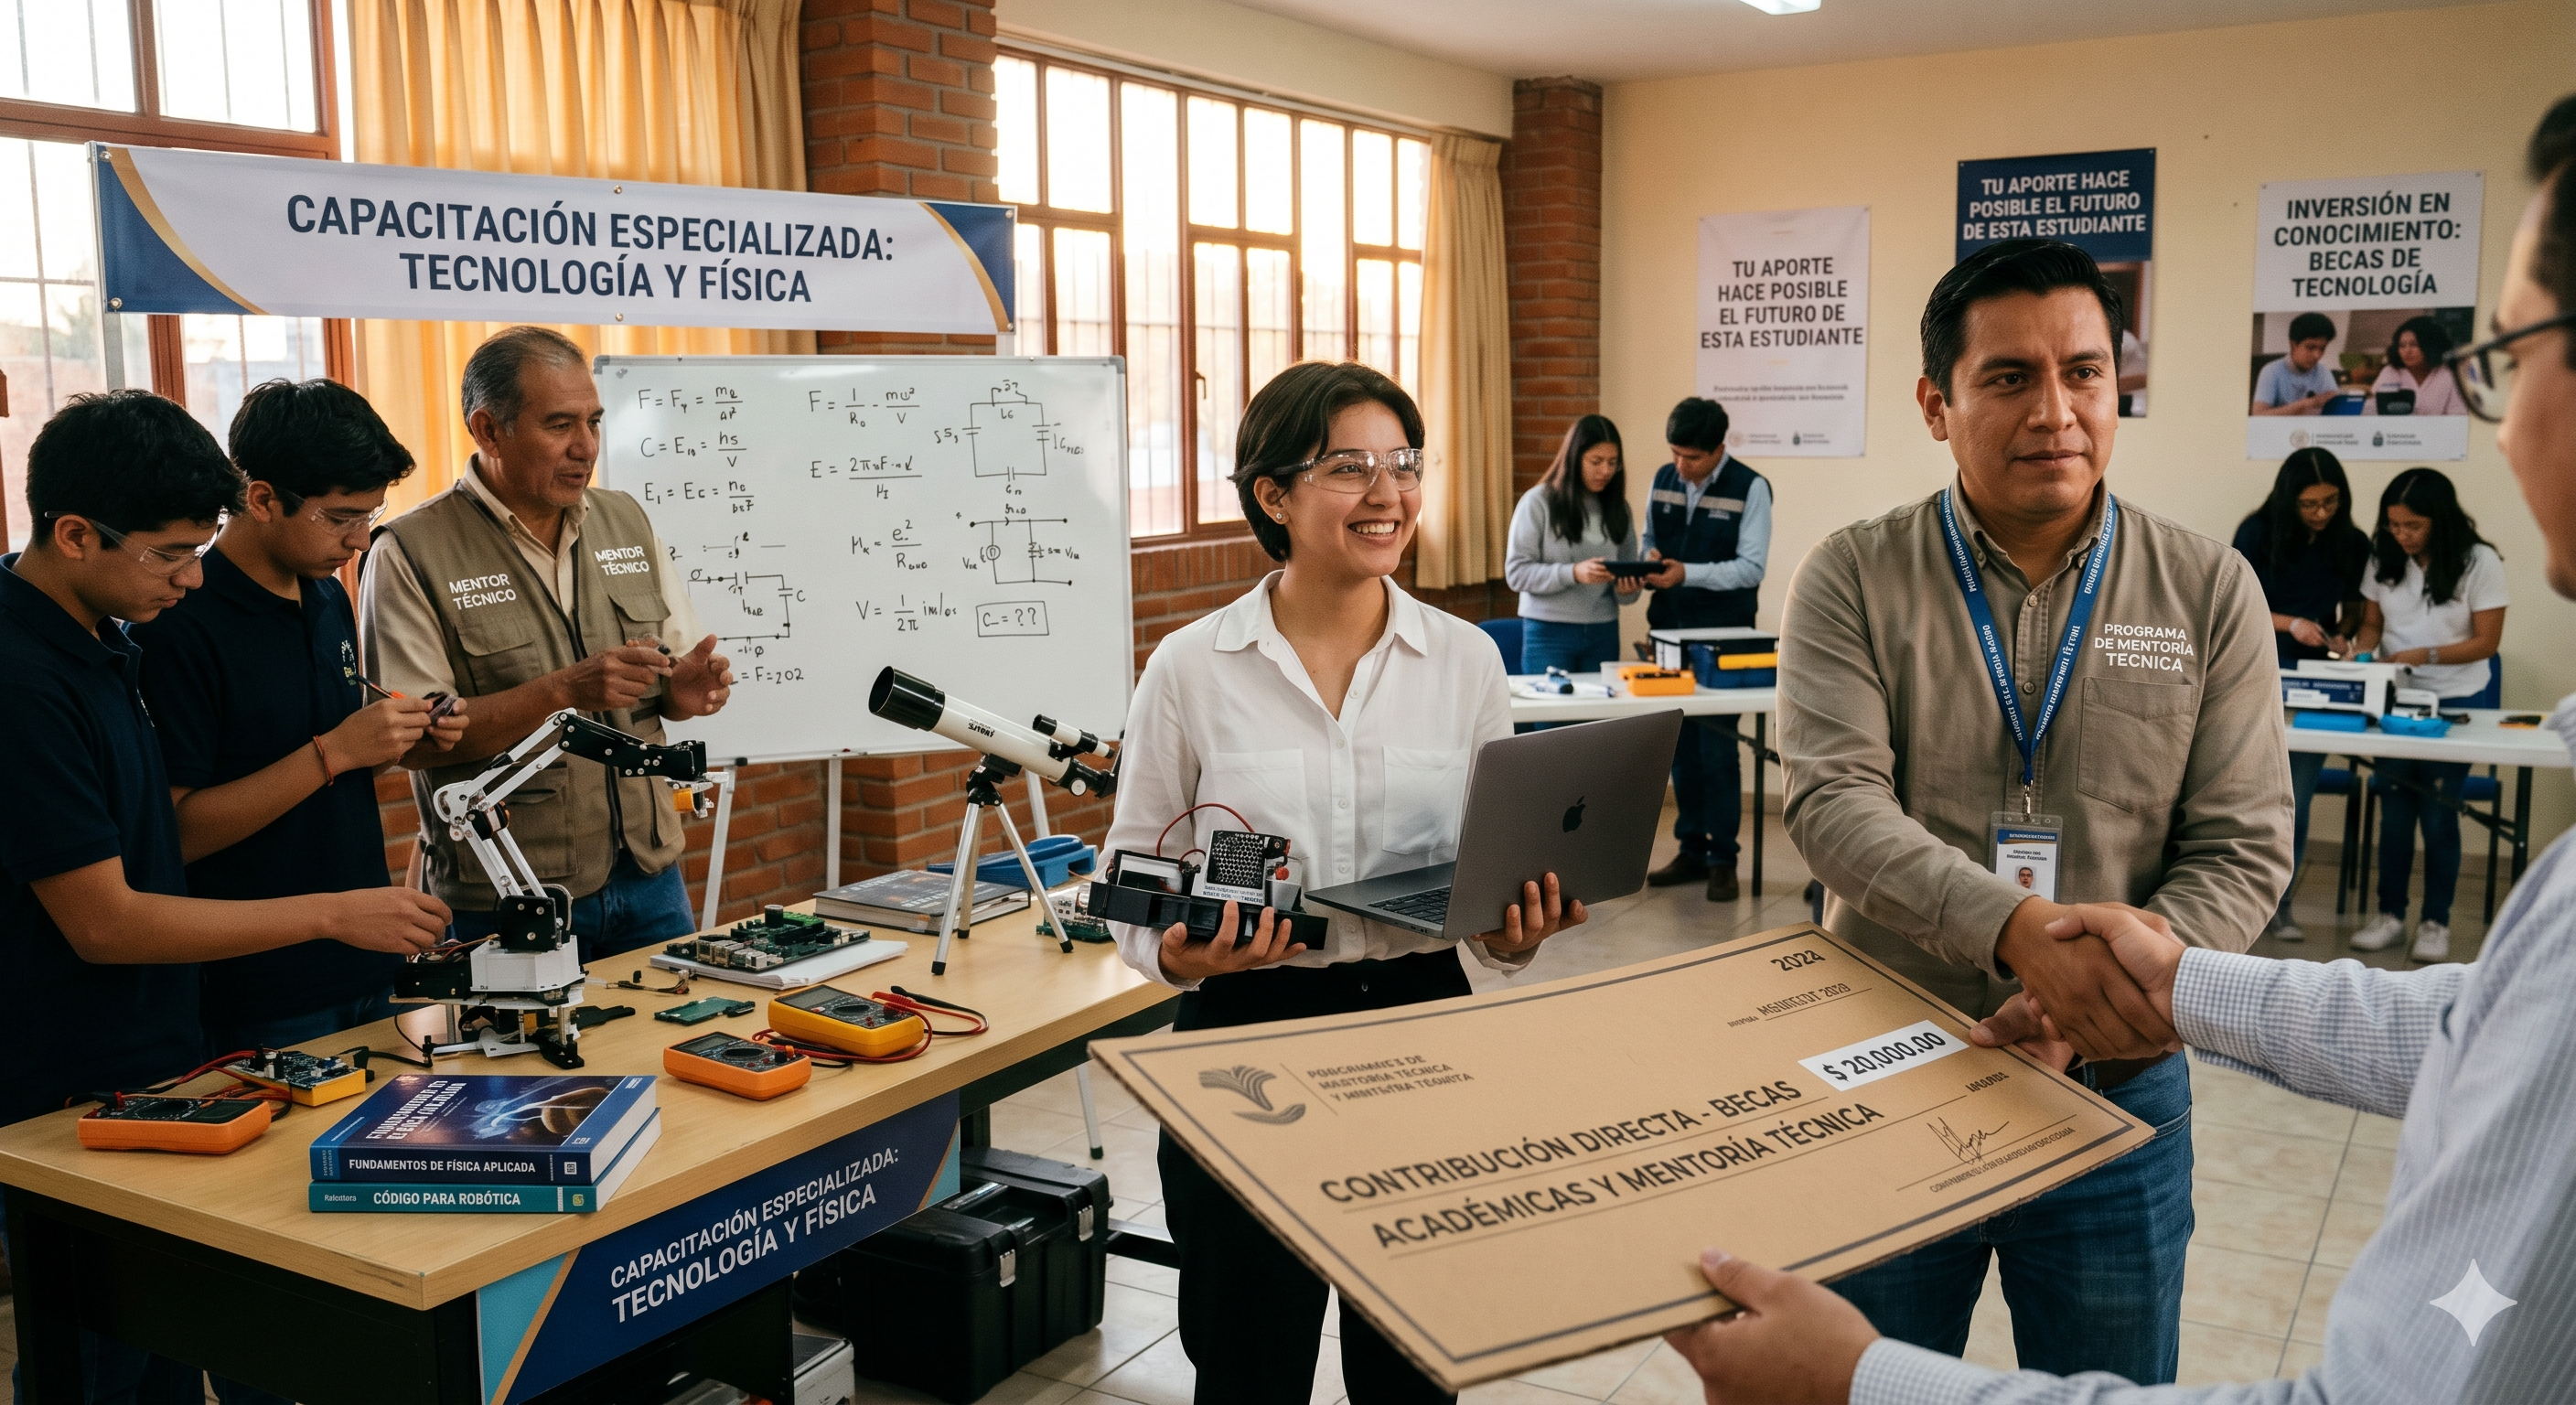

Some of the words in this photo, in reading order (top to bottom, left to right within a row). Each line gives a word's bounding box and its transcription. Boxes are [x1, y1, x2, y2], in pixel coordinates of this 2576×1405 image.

[1981, 178, 2003, 196] TU
[2007, 173, 2077, 194] APORTE
[2081, 170, 2131, 189] HACE
[1970, 198, 2041, 219] POSIBLE
[2045, 197, 2066, 214] EL
[2069, 192, 2141, 212] FUTURO
[2287, 190, 2411, 220] INVERSIÓN
[2420, 192, 2451, 213] EN
[287, 194, 596, 247] CAPACITACIÓN
[610, 213, 894, 261] ESPECIALIZADA:
[1963, 222, 1985, 240] DE
[1989, 220, 2033, 239] ESTA
[2036, 214, 2146, 236] ESTUDIANTE
[2274, 219, 2462, 246] CONOCIMIENTO:
[1733, 261, 1755, 278] TU
[1760, 257, 1833, 277] APORTE
[2309, 249, 2384, 271] BECAS
[2392, 247, 2421, 268] DE
[399, 252, 654, 298] TECNOLOGÍA
[664, 263, 688, 298] Y
[699, 258, 812, 303] FÍSICA
[2292, 269, 2437, 297] TECNOLOGÍA
[1718, 284, 1766, 302] HACE
[1771, 280, 1848, 300] POSIBLE
[1720, 307, 1739, 325] EL
[1744, 305, 1816, 324] FUTURO
[1822, 305, 1845, 322] DE
[1701, 331, 1744, 349] ESTA
[1750, 327, 1863, 347] ESTUDIANTE
[594, 545, 645, 563] MENTOR
[601, 560, 649, 576] TÉCNICO
[448, 573, 510, 595] MENTOR
[453, 588, 517, 610] TÉCNICO
[2094, 637, 2114, 649] DE
[2104, 623, 2187, 640] PROGRAMA
[2105, 652, 2184, 672] TECNICA
[1822, 1063, 1849, 1082] $
[1841, 1032, 1947, 1076] 20,000.00
[1320, 1137, 1577, 1203] CONTRIBUCIÓN
[1570, 1109, 1703, 1153] DIRECTA
[1708, 1080, 1802, 1118] BECAS
[349, 1159, 427, 1171] FUNDAMENTOS
[430, 1161, 444, 1171] DE
[446, 1159, 481, 1172] FÍSICA
[483, 1162, 536, 1173] APLICADA
[1372, 1182, 1597, 1249] ACADÉMICAS
[1589, 1174, 1620, 1198] Y
[1616, 1135, 1776, 1192] MENTORÍA
[1764, 1103, 1884, 1150] TÉCNICA
[373, 1190, 420, 1205] CÓDIGO
[423, 1192, 456, 1205] PARA
[458, 1190, 521, 1206] ROBÓTICA
[610, 1206, 757, 1289] CAPACITACIÓN
[763, 1147, 899, 1222] ESPECIALIZADA:
[612, 1227, 778, 1324] TECNOLOGÍA
[784, 1217, 800, 1243] Y
[805, 1184, 876, 1235] FÍSICA
